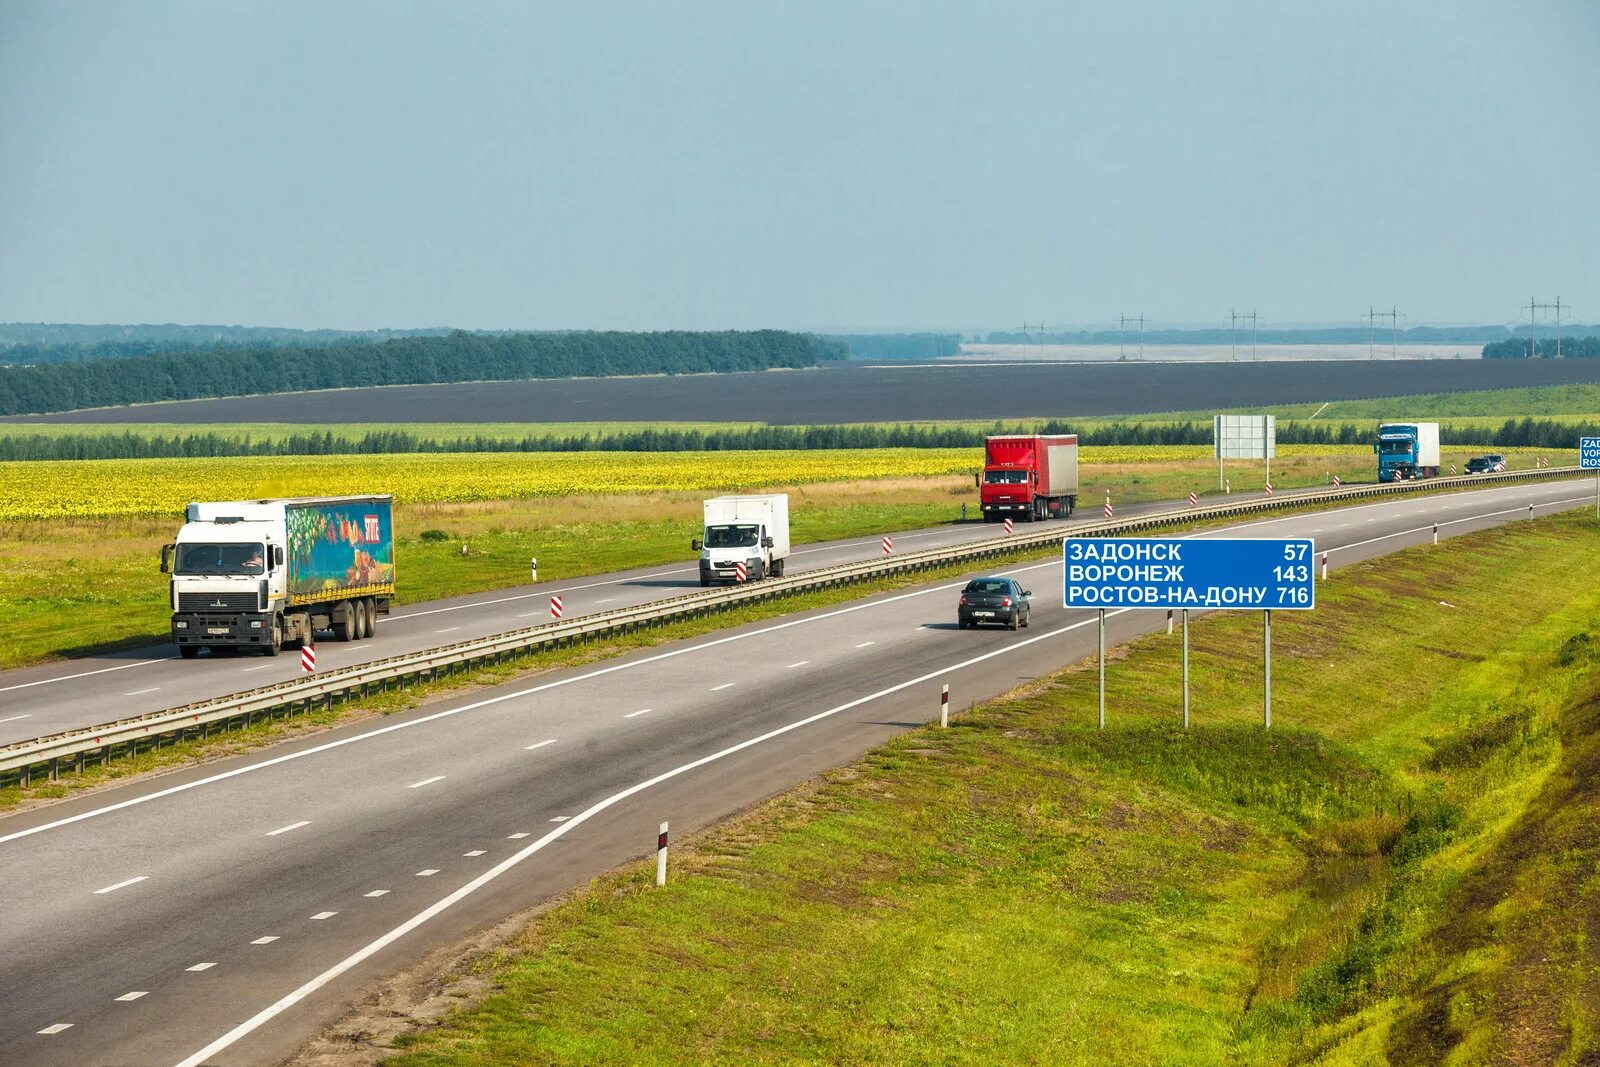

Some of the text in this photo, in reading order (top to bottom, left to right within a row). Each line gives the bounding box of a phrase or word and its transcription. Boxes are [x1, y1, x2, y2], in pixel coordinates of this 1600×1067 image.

[1070, 543, 1308, 563] ЗАДОНСК 57
[1069, 564, 1308, 582] ВОРОНЕЖ 143
[1069, 586, 1308, 606] РОСТОВ-НА-ДОНУ 716
